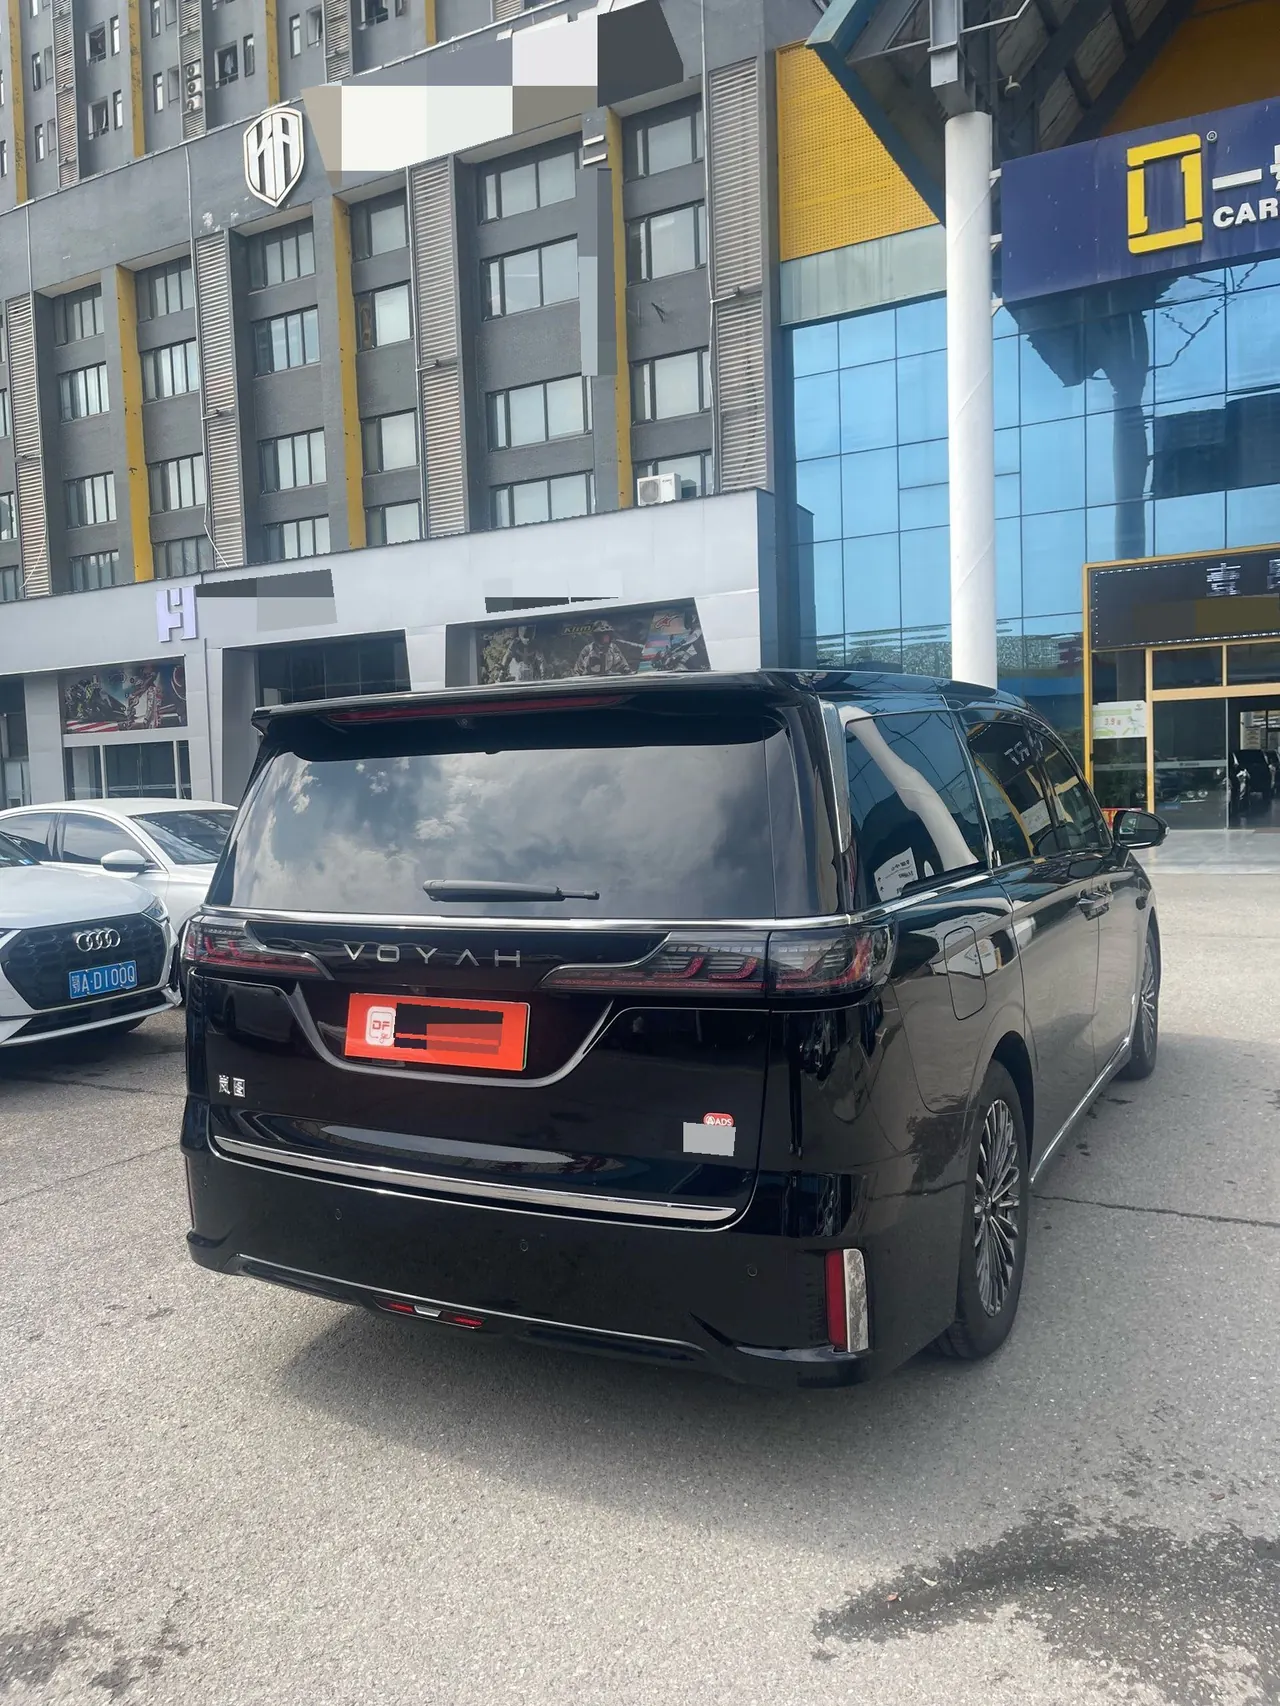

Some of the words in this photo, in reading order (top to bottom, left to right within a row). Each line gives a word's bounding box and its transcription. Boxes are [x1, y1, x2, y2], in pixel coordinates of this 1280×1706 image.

[1212, 197, 1279, 228] CAR
[343, 943, 521, 968] VOYAH
[714, 1117, 732, 1127] ADS
